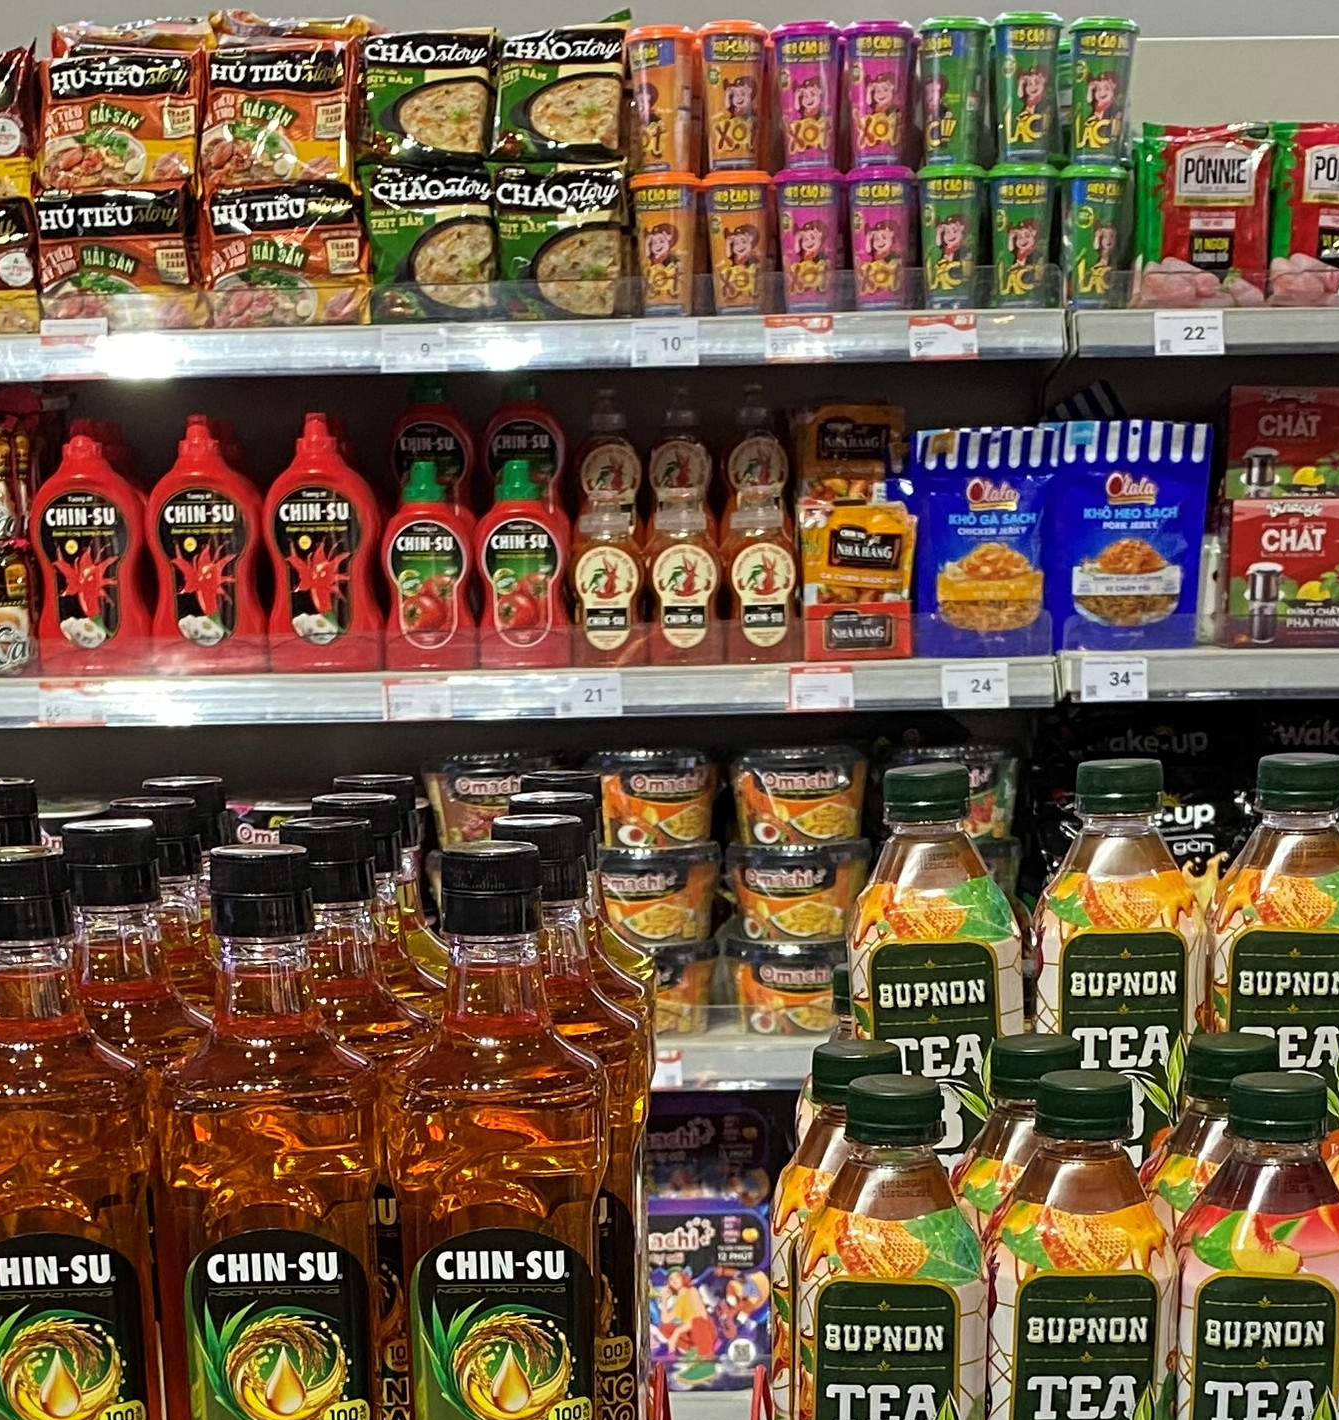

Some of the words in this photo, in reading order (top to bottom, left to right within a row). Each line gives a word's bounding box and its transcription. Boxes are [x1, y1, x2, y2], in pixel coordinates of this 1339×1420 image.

[364, 39, 436, 64] CHÁO
[1183, 326, 1204, 340] 22
[661, 337, 681, 350] 10
[45, 507, 116, 526] CHIN-SU
[279, 502, 350, 522] CHIN-SU
[1115, 508, 1141, 519] HEO
[396, 535, 454, 551] CHIN-SU
[491, 534, 549, 549] CHIN-SU
[1286, 618, 1309, 627] PHA
[1313, 618, 1339, 627] PHIN
[971, 680, 991, 693] 24
[1110, 673, 1130, 686] 34
[584, 689, 603, 702] 21
[878, 980, 986, 1008] BUPNON
[1070, 971, 1177, 998] BUPNON
[207, 1252, 339, 1283] CHIN-SU
[436, 1250, 565, 1280] CHIN-SU
[824, 1326, 944, 1352] BUPNON
[1205, 1321, 1324, 1347] BUPNON
[1027, 1377, 1137, 1420] TEA
